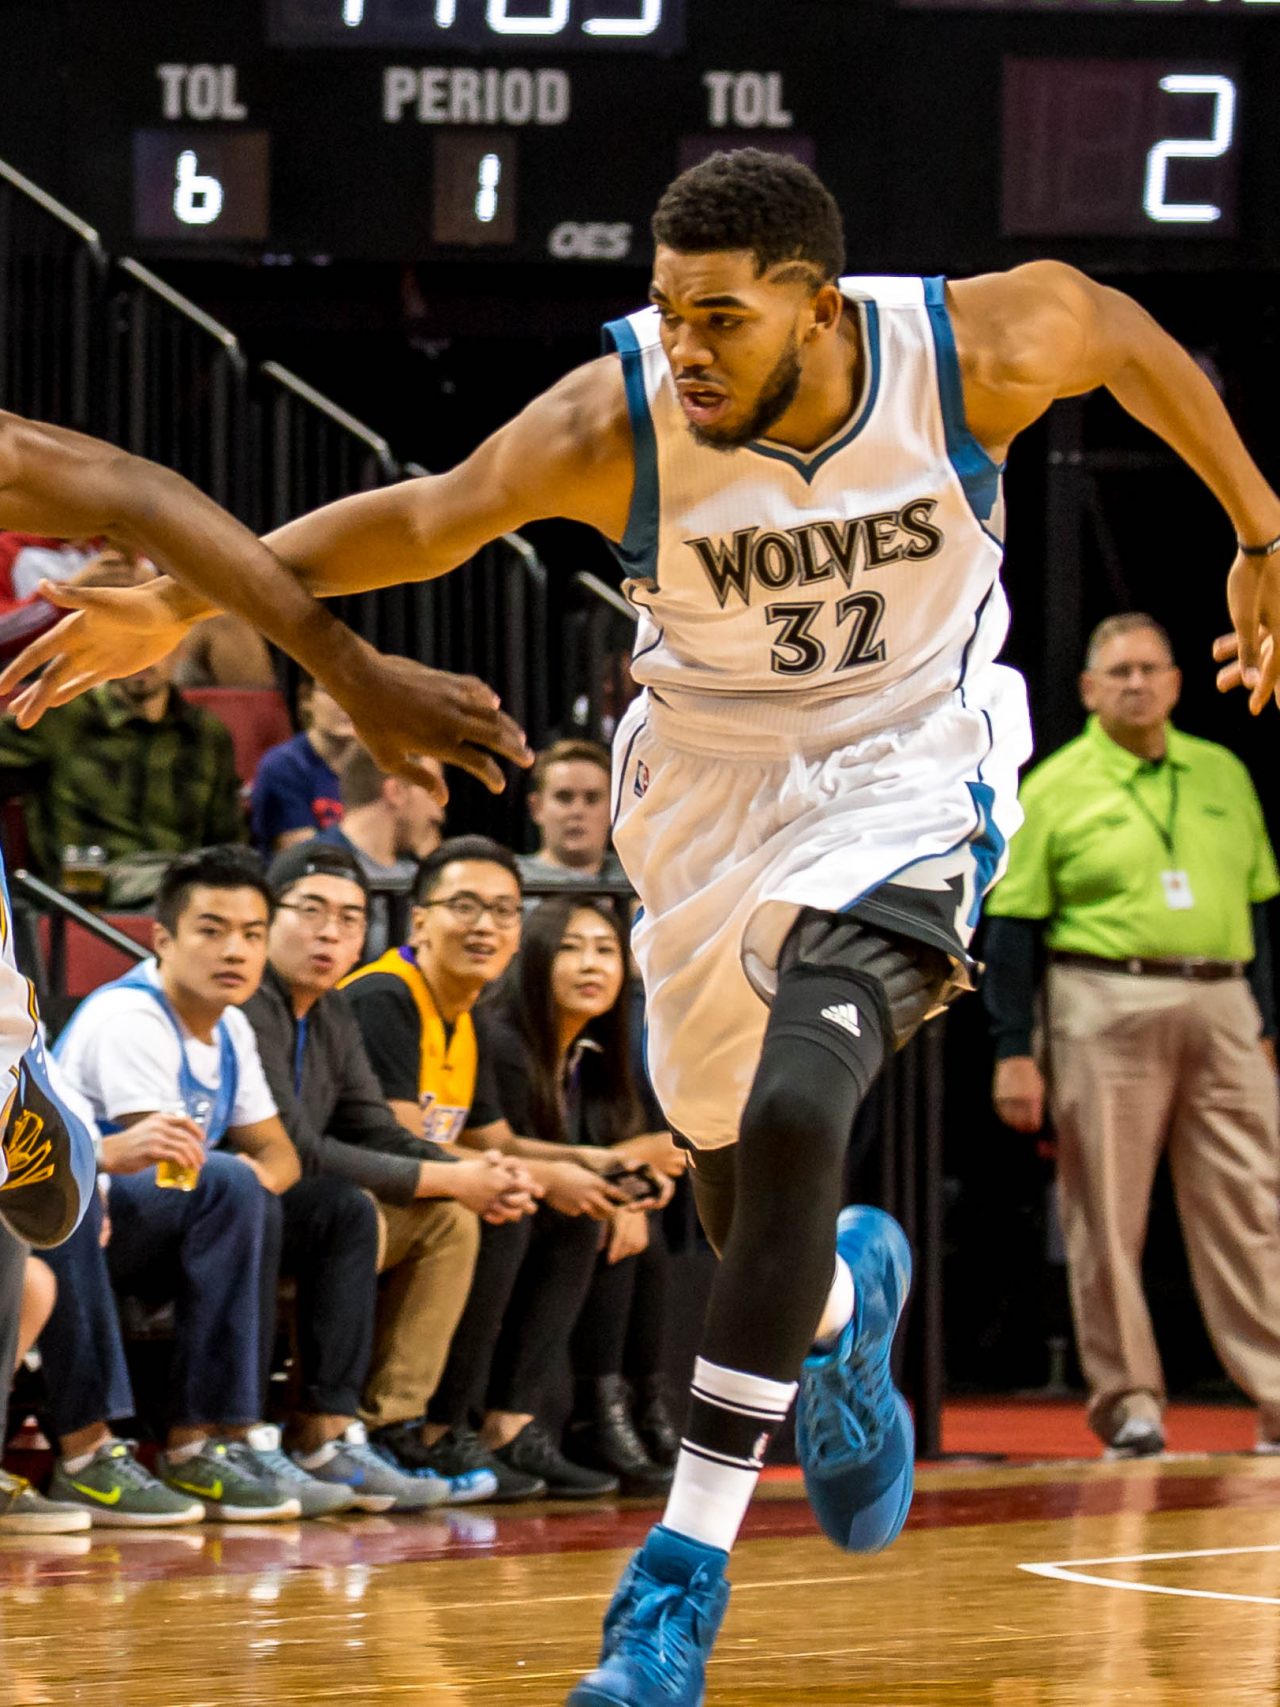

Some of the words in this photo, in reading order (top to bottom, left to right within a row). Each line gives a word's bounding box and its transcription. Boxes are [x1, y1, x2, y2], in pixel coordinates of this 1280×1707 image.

[157, 64, 247, 120] TOL
[383, 66, 570, 124] PERIOD
[704, 71, 793, 128] TOL
[1143, 75, 1236, 222] 2
[174, 150, 223, 224] 6
[476, 153, 500, 222] 1
[683, 498, 944, 609] WOLVES
[765, 590, 887, 676] 32
